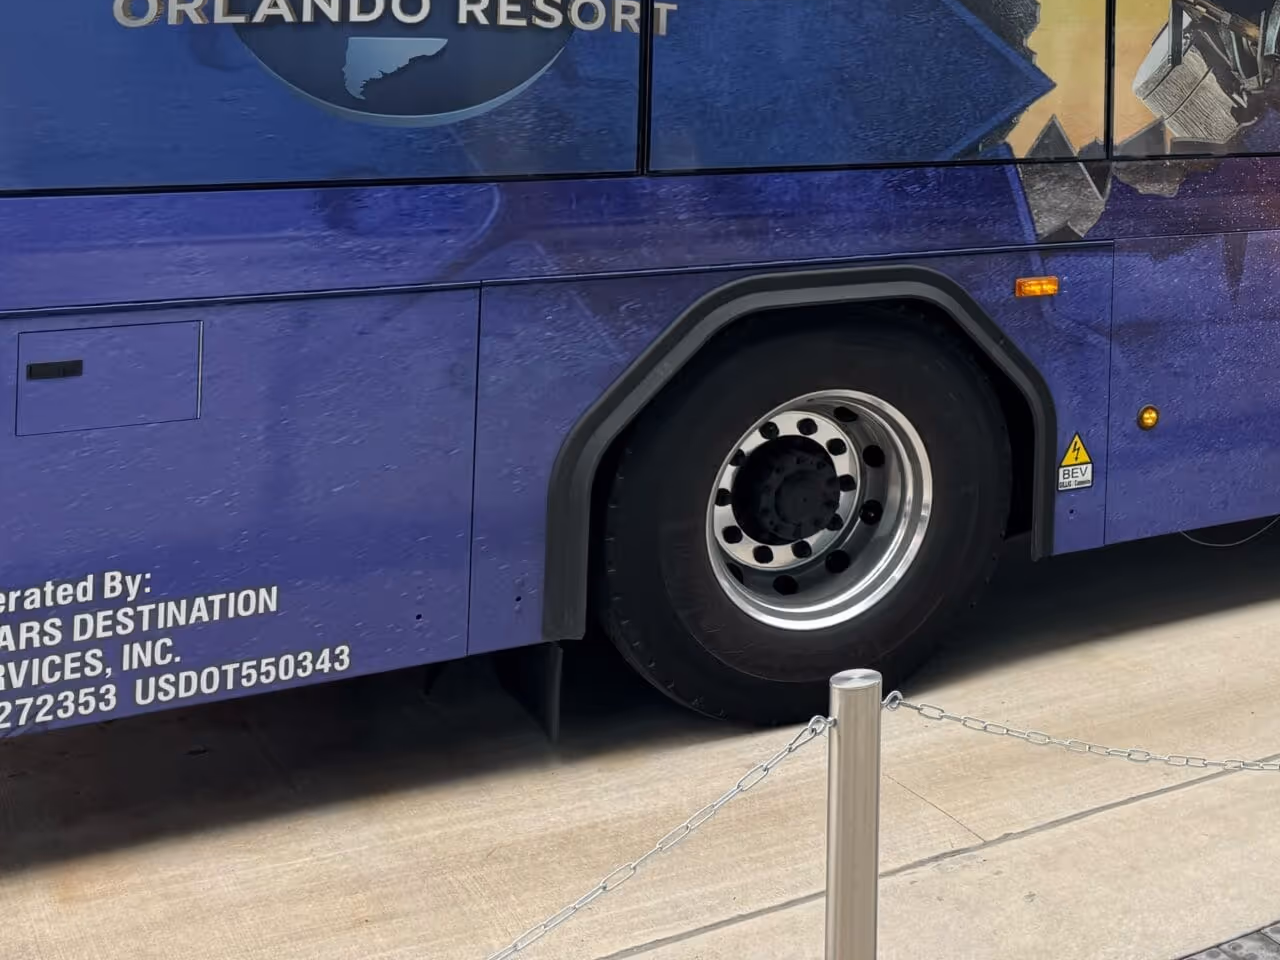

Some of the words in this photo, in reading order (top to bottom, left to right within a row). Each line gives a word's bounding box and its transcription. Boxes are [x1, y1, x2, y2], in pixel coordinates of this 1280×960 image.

[1062, 466, 1089, 480] BEV
[104, 570, 152, 601] By:
[72, 586, 278, 643] DESTINATION
[0, 649, 112, 692] VICES,
[122, 638, 181, 672] INC.
[135, 645, 350, 706] USDOT550343
